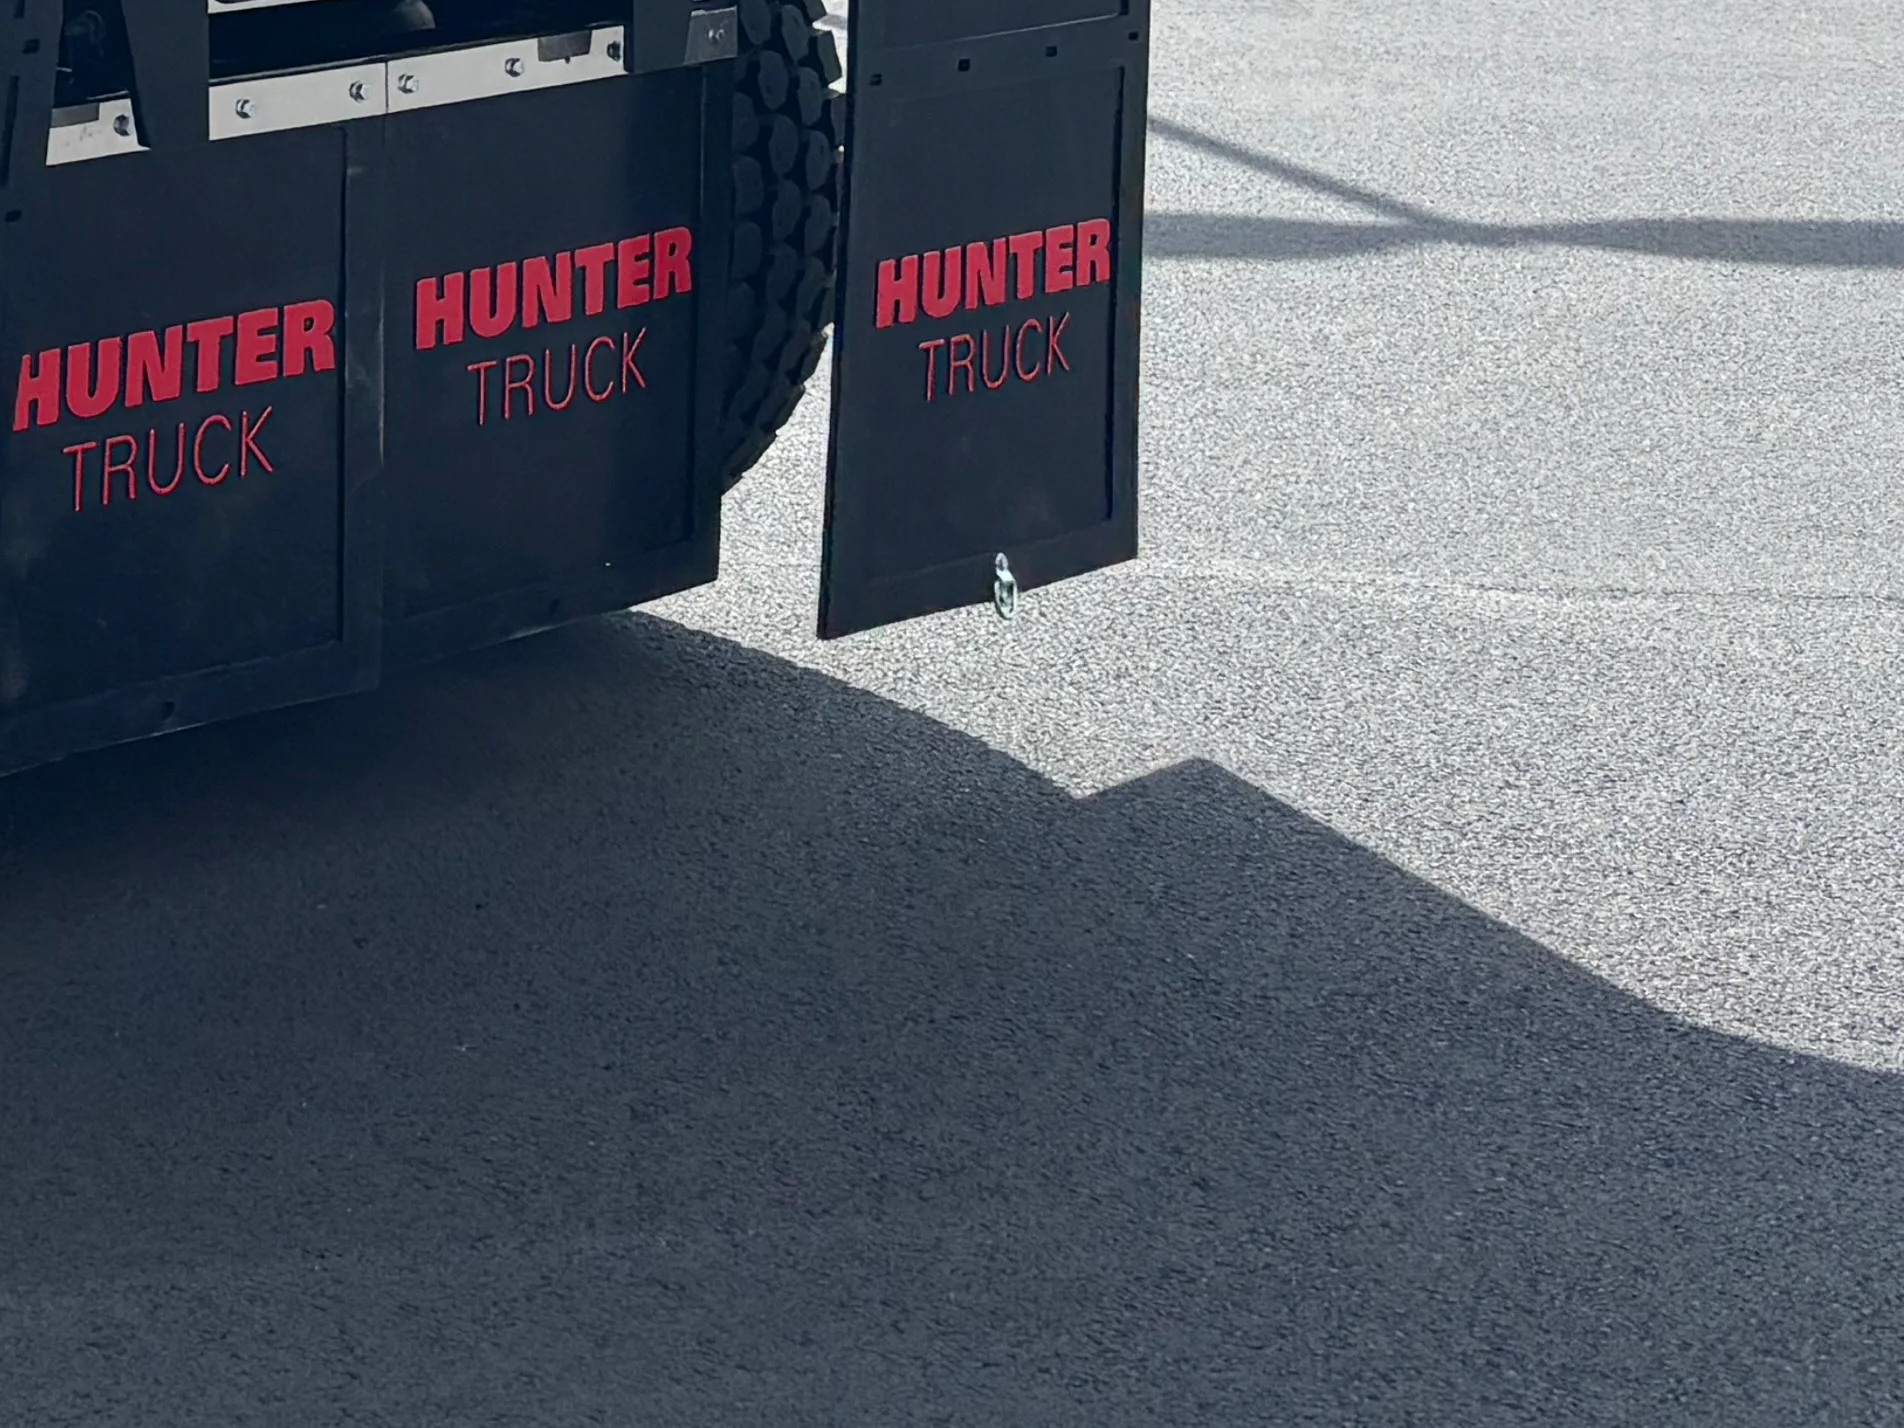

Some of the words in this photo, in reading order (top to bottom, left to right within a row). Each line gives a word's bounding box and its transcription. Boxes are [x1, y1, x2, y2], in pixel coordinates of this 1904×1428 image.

[416, 227, 693, 351] HUNTER
[876, 219, 1111, 330] HUNTER
[11, 298, 337, 432] HUNTER
[466, 328, 647, 427] TRUCK
[918, 312, 1071, 402] TRUCK
[61, 405, 274, 514] TRUCK
